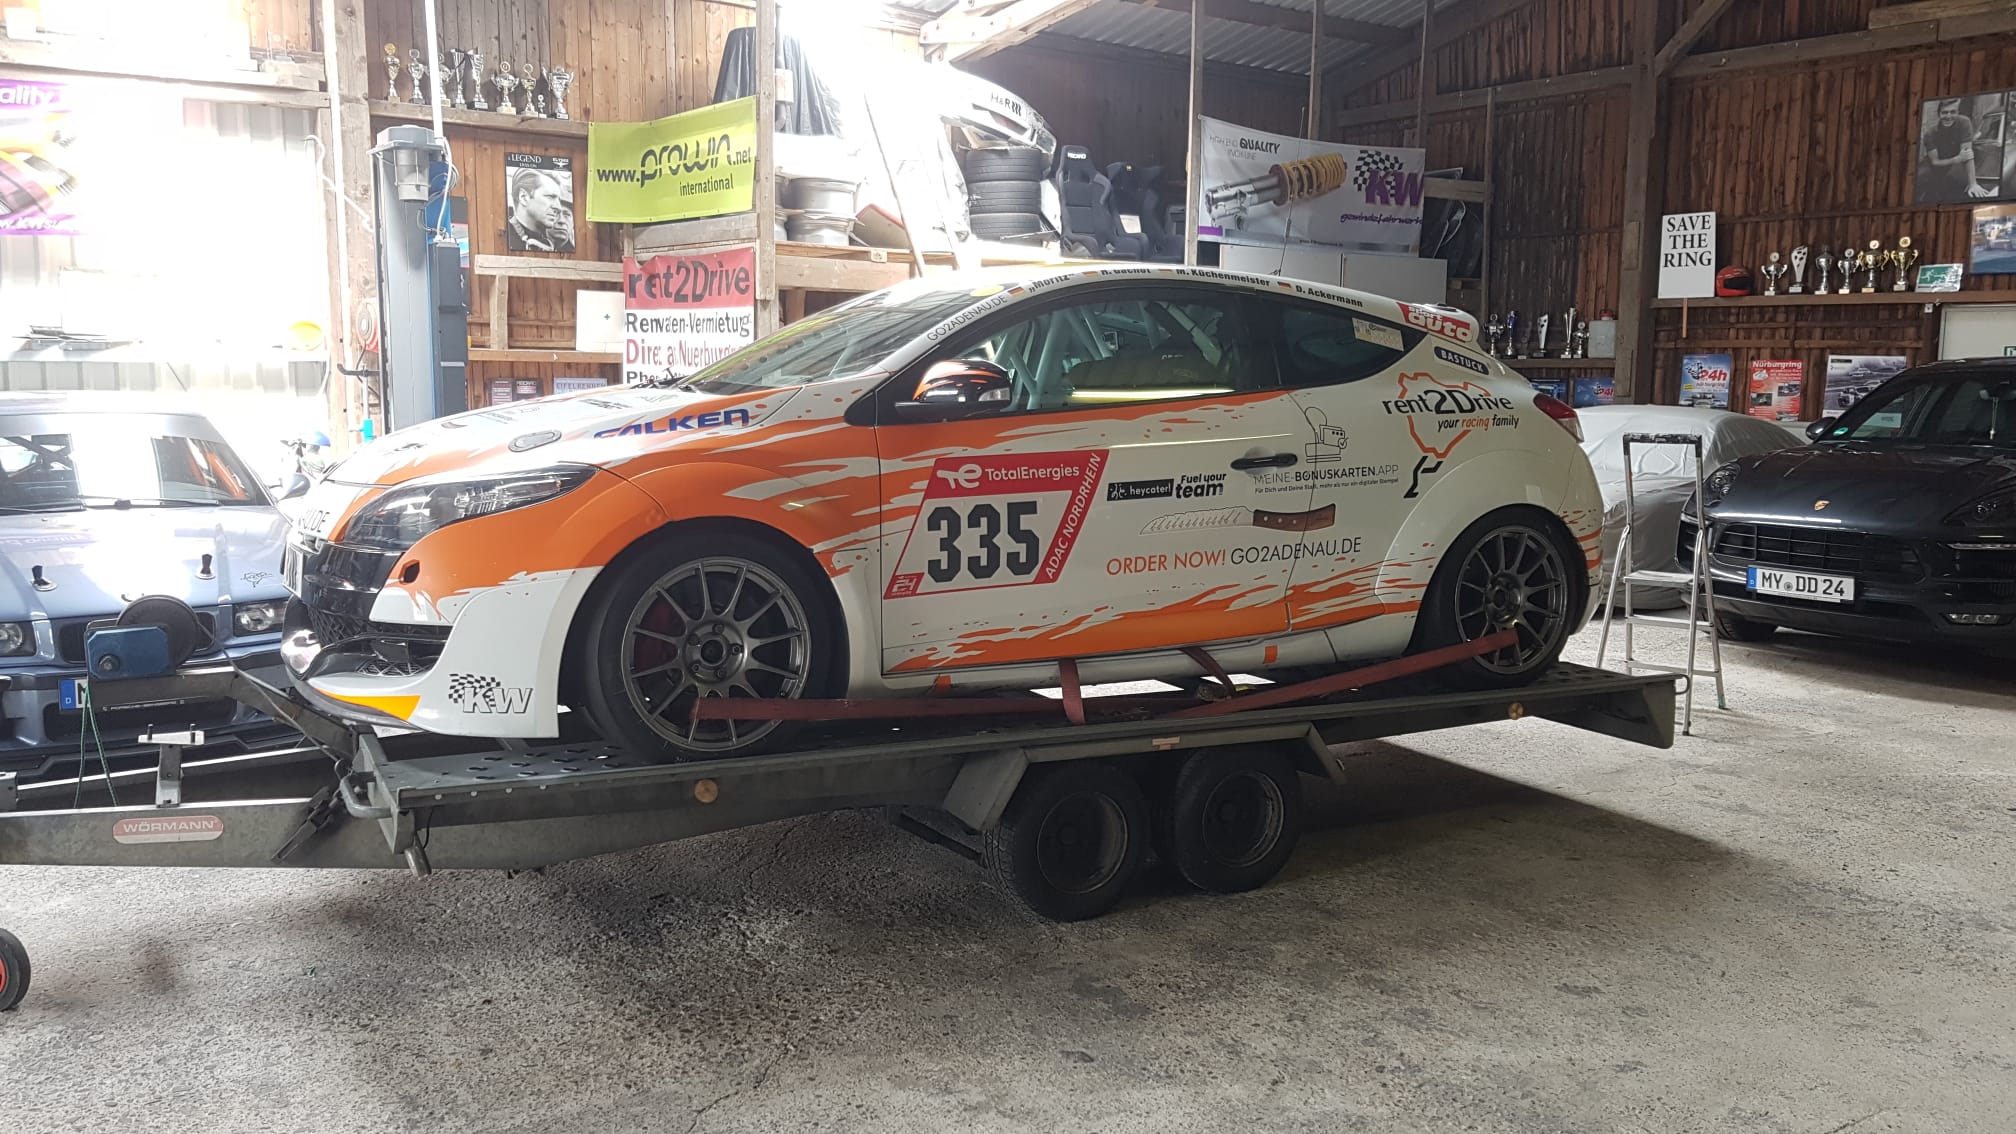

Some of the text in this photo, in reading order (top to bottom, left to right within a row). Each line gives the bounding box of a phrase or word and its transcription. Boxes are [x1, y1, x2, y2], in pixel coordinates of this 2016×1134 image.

[1240, 137, 1280, 154] QUALITY
[511, 153, 542, 164] LEGEND
[680, 174, 733, 197] international
[1667, 215, 1711, 232] SAVE
[1669, 233, 1708, 249] THE
[1664, 251, 1712, 268] RING
[1191, 268, 1270, 287] Küchenmeister
[1296, 285, 1363, 307] D. Ackermann
[927, 295, 1008, 341] GO2ADENAU.DE
[1408, 312, 1473, 342] auto
[1441, 349, 1484, 373] BASTUCK
[1753, 359, 1802, 369] Nürburgring
[1701, 369, 1727, 381] 24h
[1382, 389, 1514, 414] rent2Drive
[594, 408, 749, 438] FALKEN
[1437, 414, 1519, 432] your racing family
[985, 464, 1080, 481] TotalEnergies
[1181, 473, 1227, 484] Fuel your
[1254, 464, 1399, 485] MEINE-BONUSKARTEN.APP
[1129, 482, 1171, 497] heycater!
[1176, 482, 1224, 498] team
[1045, 453, 1101, 579] ADAC NORDRHEIN
[928, 500, 1039, 583] 335
[1106, 537, 1362, 576] ORDER NOW! GO2ADENAU.DE
[1762, 571, 1783, 590] MY
[1795, 575, 1818, 593] DD
[1822, 578, 1845, 597] 24
[463, 686, 533, 714] KW
[123, 820, 215, 834] WÖRMANN
